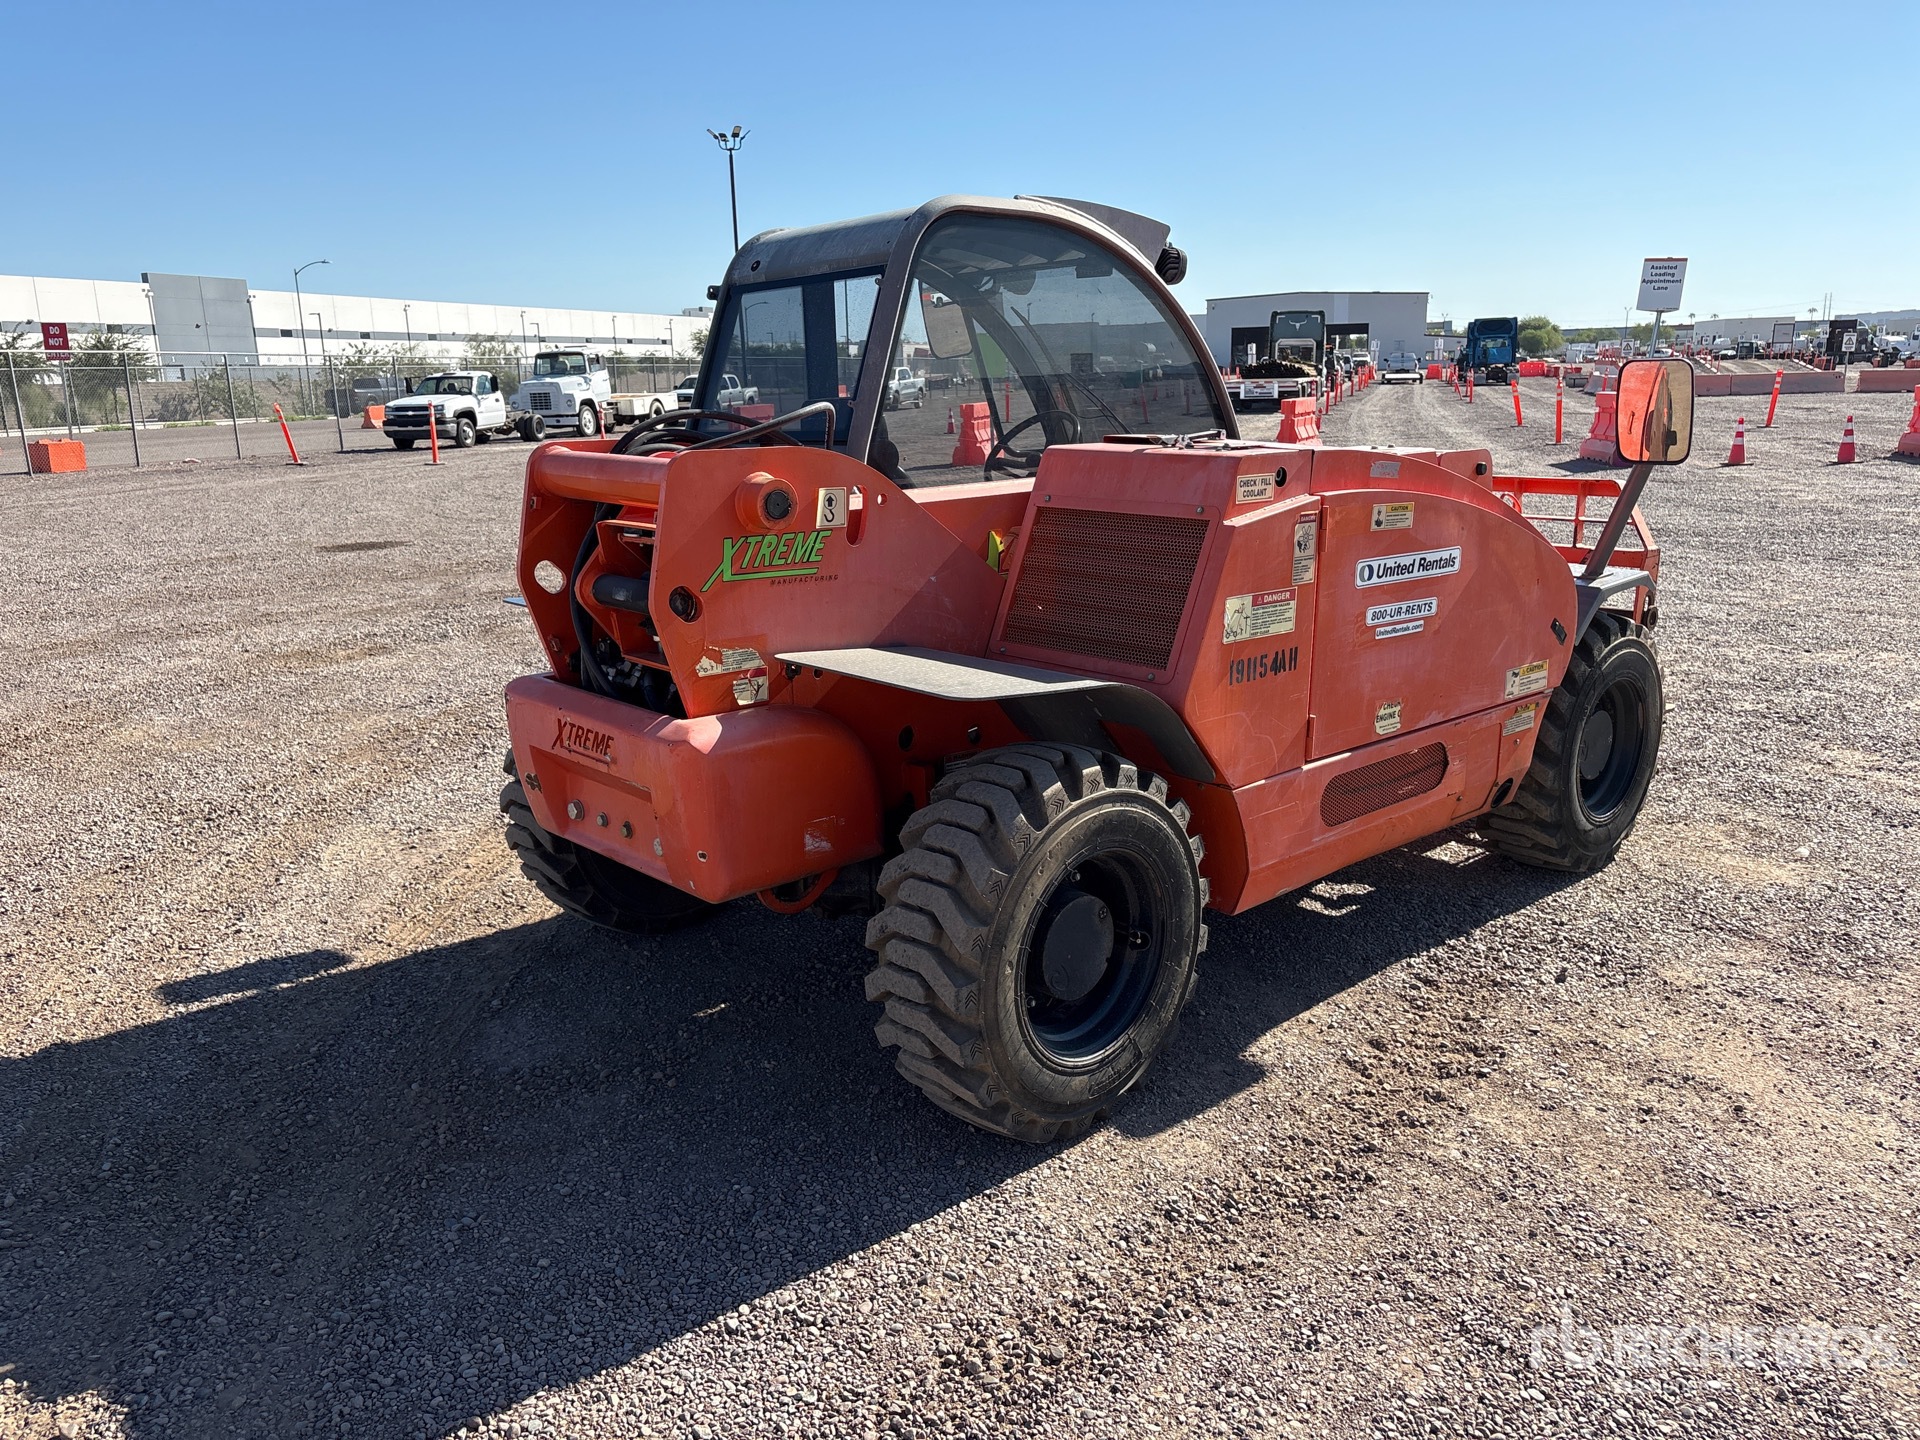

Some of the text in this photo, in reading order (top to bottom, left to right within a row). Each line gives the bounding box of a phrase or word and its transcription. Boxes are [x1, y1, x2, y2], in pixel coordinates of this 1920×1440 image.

[48, 326, 60, 335] DO
[48, 337, 64, 346] NOT
[1239, 479, 1258, 488] CHECK
[1260, 477, 1272, 486] FILL
[1242, 488, 1268, 498] COOLANT
[700, 530, 832, 592] XTREME
[1376, 552, 1457, 579] United Rentals
[769, 574, 840, 585] MANUFACTURING
[1263, 591, 1291, 603] DANGER
[1371, 601, 1433, 621] 800-UR-RENTS
[1376, 623, 1423, 637] UnitedRentals.com
[1229, 646, 1298, 686] 191154AH
[1525, 664, 1544, 673] CAUTION
[1376, 710, 1397, 723] ENGINE
[551, 717, 615, 760] XTREME
